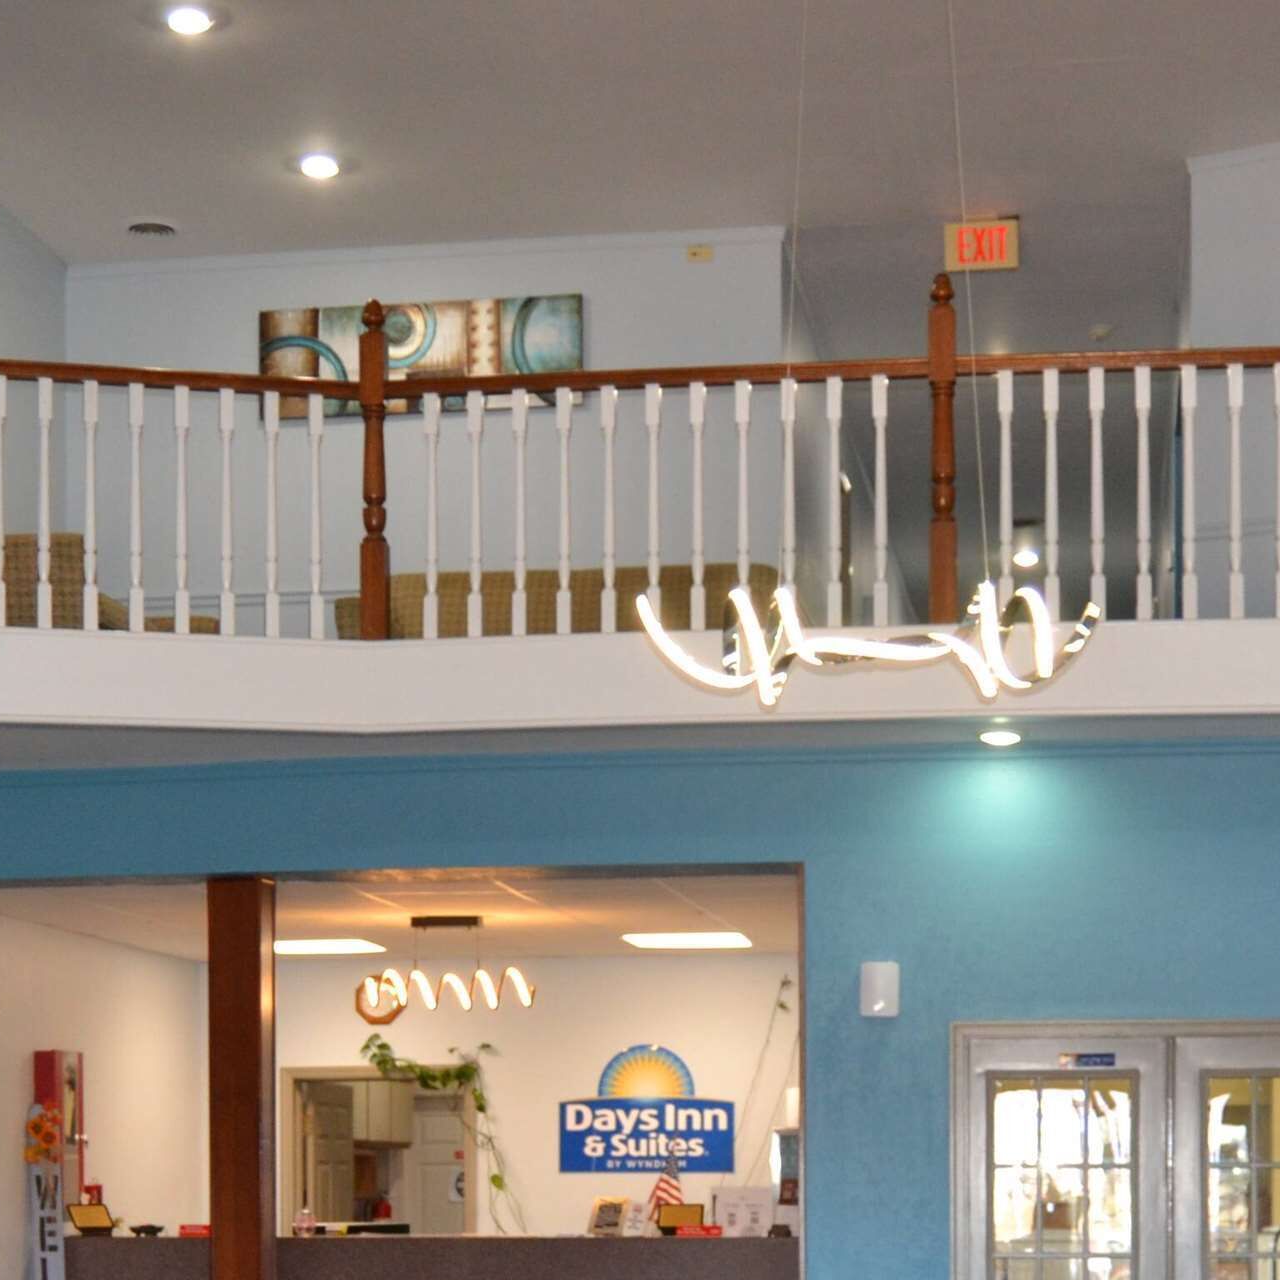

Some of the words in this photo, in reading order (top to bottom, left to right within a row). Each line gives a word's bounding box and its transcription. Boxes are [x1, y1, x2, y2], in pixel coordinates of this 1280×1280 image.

[957, 224, 1008, 264] EXIT
[565, 1104, 660, 1135] Days
[664, 1103, 729, 1131] Inn
[583, 1134, 606, 1157] &
[610, 1133, 705, 1157] Suites
[606, 1160, 621, 1169] BY
